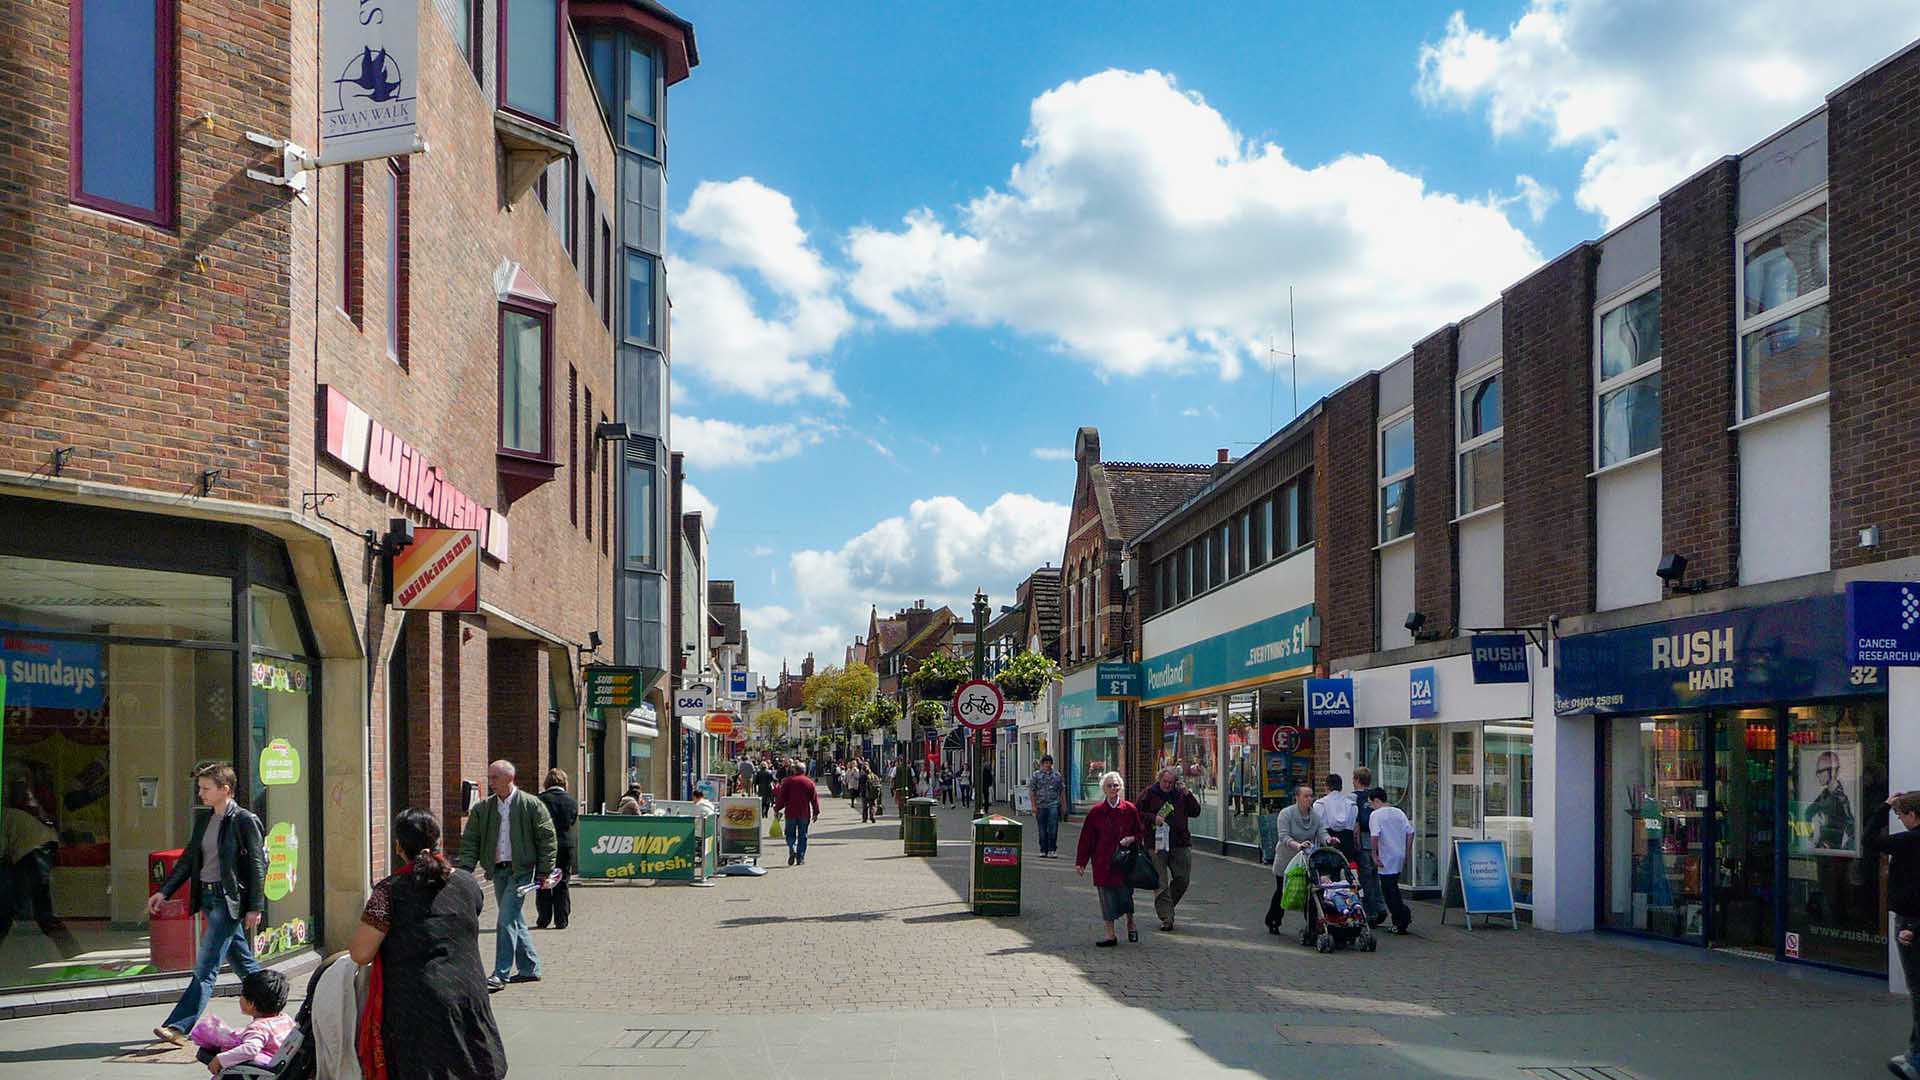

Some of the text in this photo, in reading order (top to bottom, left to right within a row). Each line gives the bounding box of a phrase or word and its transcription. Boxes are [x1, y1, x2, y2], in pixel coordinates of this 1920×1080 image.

[359, 0, 384, 25] S
[329, 112, 368, 127] SWAN
[370, 103, 409, 121] WALK
[1652, 627, 1734, 670] RUSH
[1858, 639, 1897, 649] CANCER
[1475, 647, 1525, 662] RUSH
[1858, 651, 1909, 661] RESEARCH
[12, 657, 95, 694] sundays
[1147, 658, 1184, 691] Poundland
[1499, 662, 1526, 672] HAIR
[1850, 666, 1878, 685] 32
[1110, 680, 1128, 695] £1
[1411, 679, 1431, 699] D&A
[1688, 667, 1734, 691] HAIR
[678, 697, 703, 708] C&G
[1312, 691, 1350, 710] D&A
[591, 835, 682, 855] SUBWAY
[606, 855, 692, 878] eat fresh.
